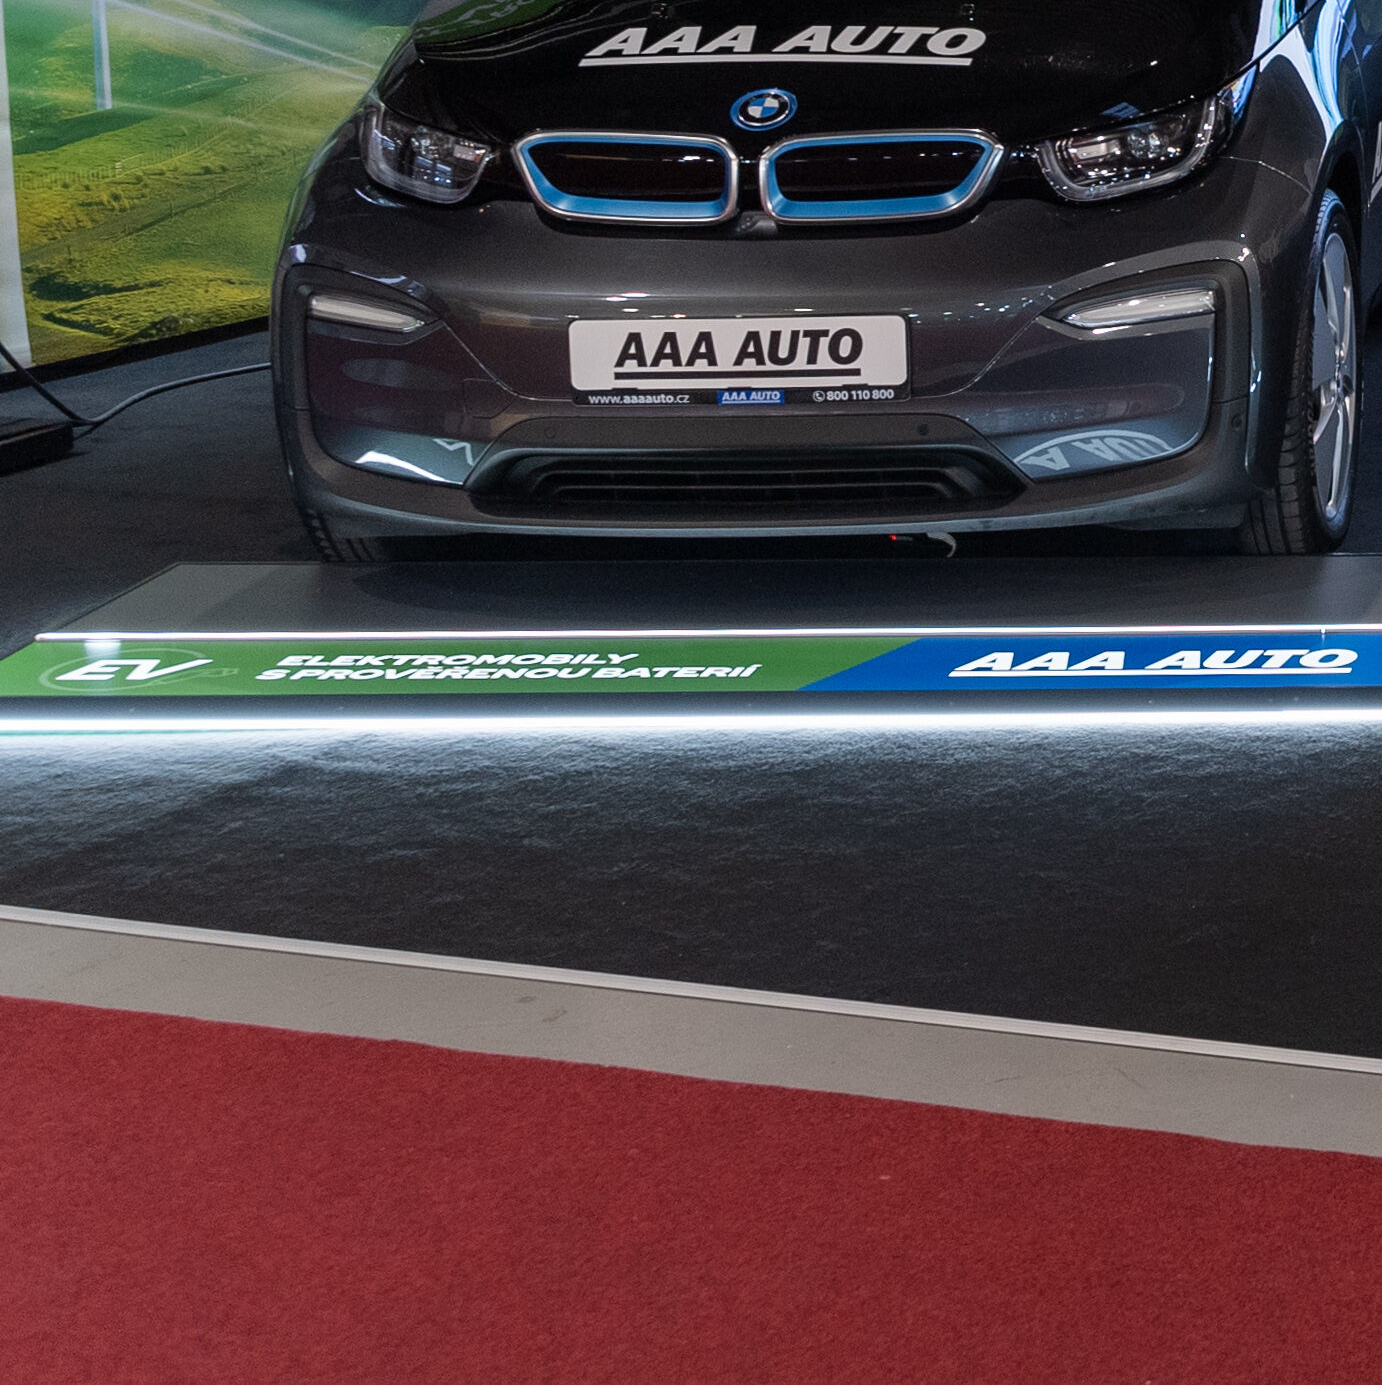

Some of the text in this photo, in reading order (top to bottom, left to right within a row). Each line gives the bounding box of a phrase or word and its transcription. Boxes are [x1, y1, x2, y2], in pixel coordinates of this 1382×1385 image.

[584, 25, 986, 56] AAA AUTO
[614, 328, 863, 367] AAA AUTO
[589, 394, 690, 405] www.aaaauto.cz
[722, 391, 780, 401] AAA AUTO
[827, 389, 894, 401] 800 110 800
[277, 652, 640, 666] ELEKTROMOBILY
[955, 648, 1359, 671] AAA AUTO
[55, 659, 213, 681] EV
[256, 664, 762, 681] S PROVĚŘENOU BATERIÍ
